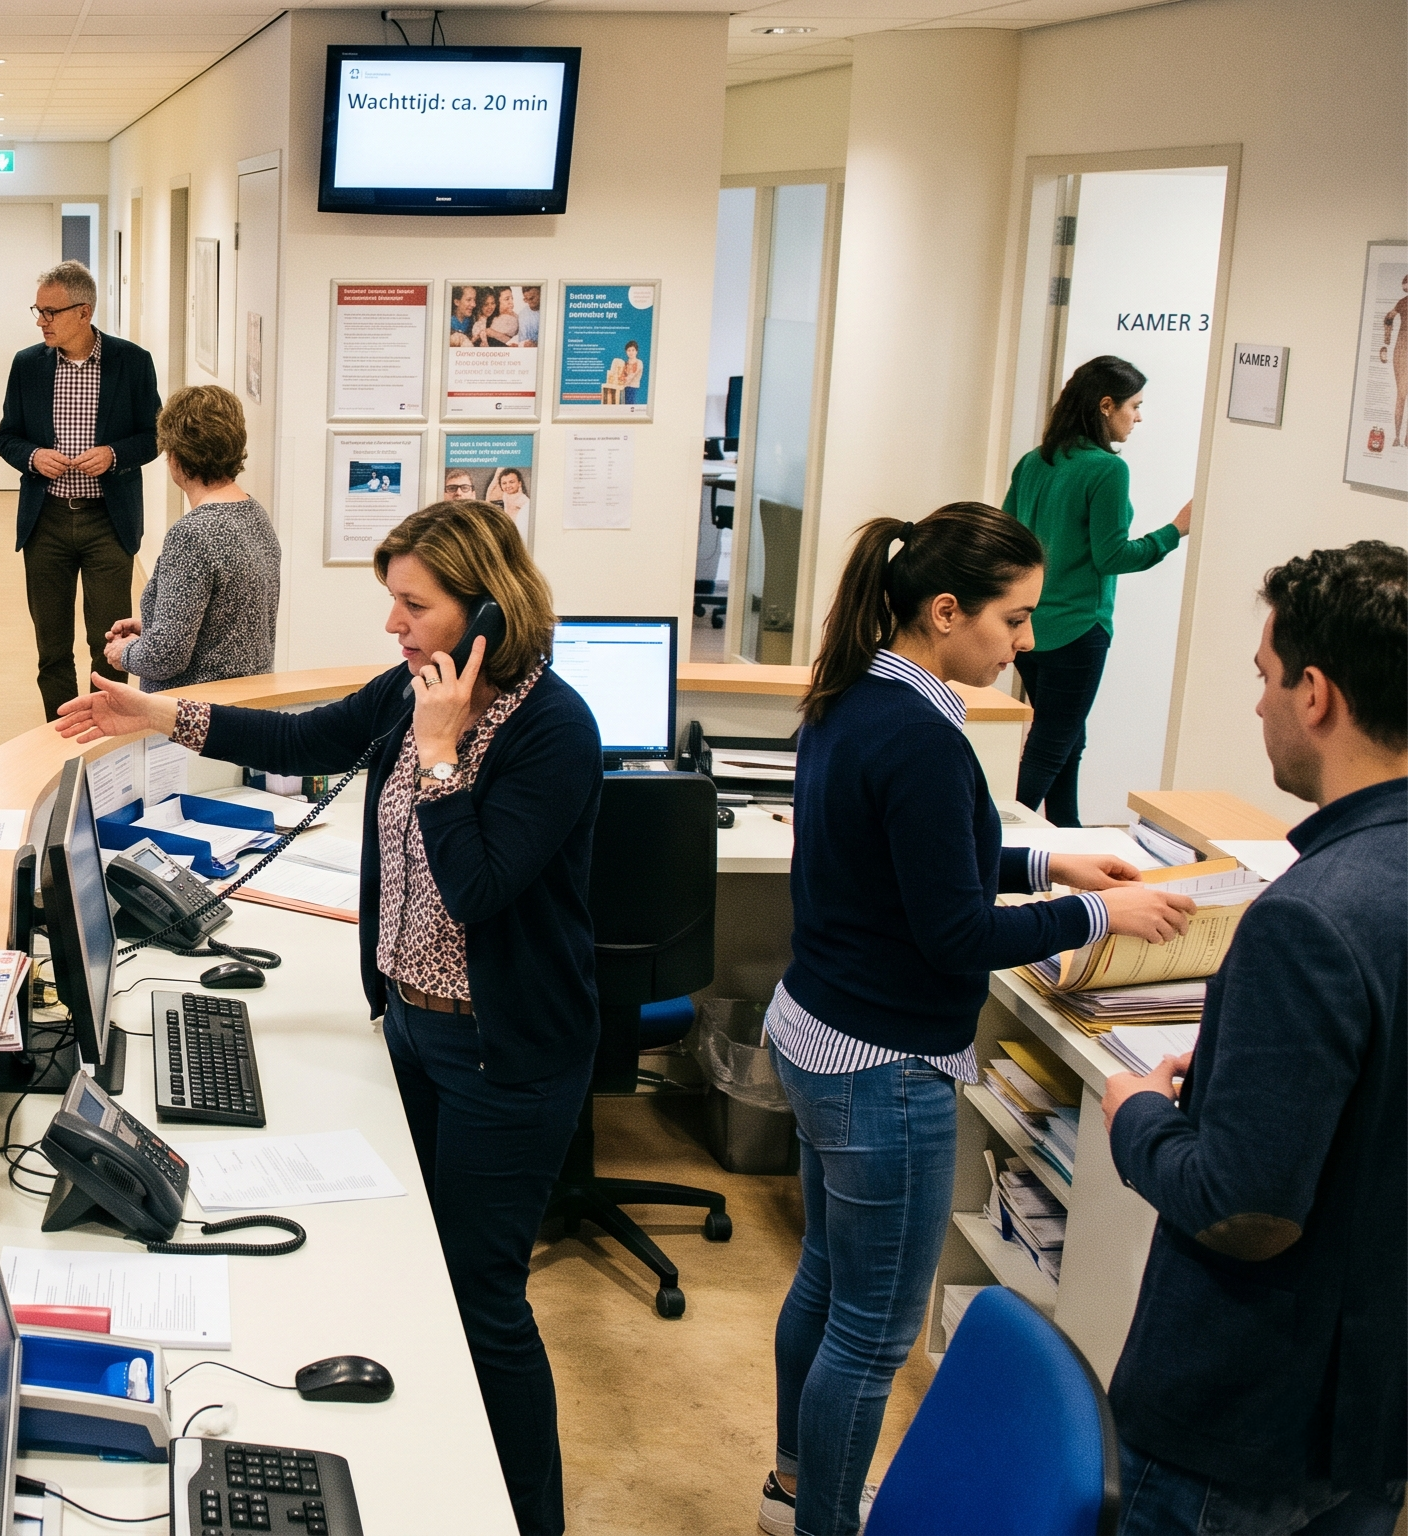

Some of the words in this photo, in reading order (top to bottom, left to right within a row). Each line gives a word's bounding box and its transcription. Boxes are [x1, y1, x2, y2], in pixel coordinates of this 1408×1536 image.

[348, 93, 446, 114] Wachttijd:
[451, 98, 477, 111] ca.
[483, 94, 507, 111] 20
[512, 94, 548, 111] min
[1117, 313, 1191, 332] KAMER
[1198, 313, 1210, 332] 3
[1239, 352, 1271, 367] KAMER
